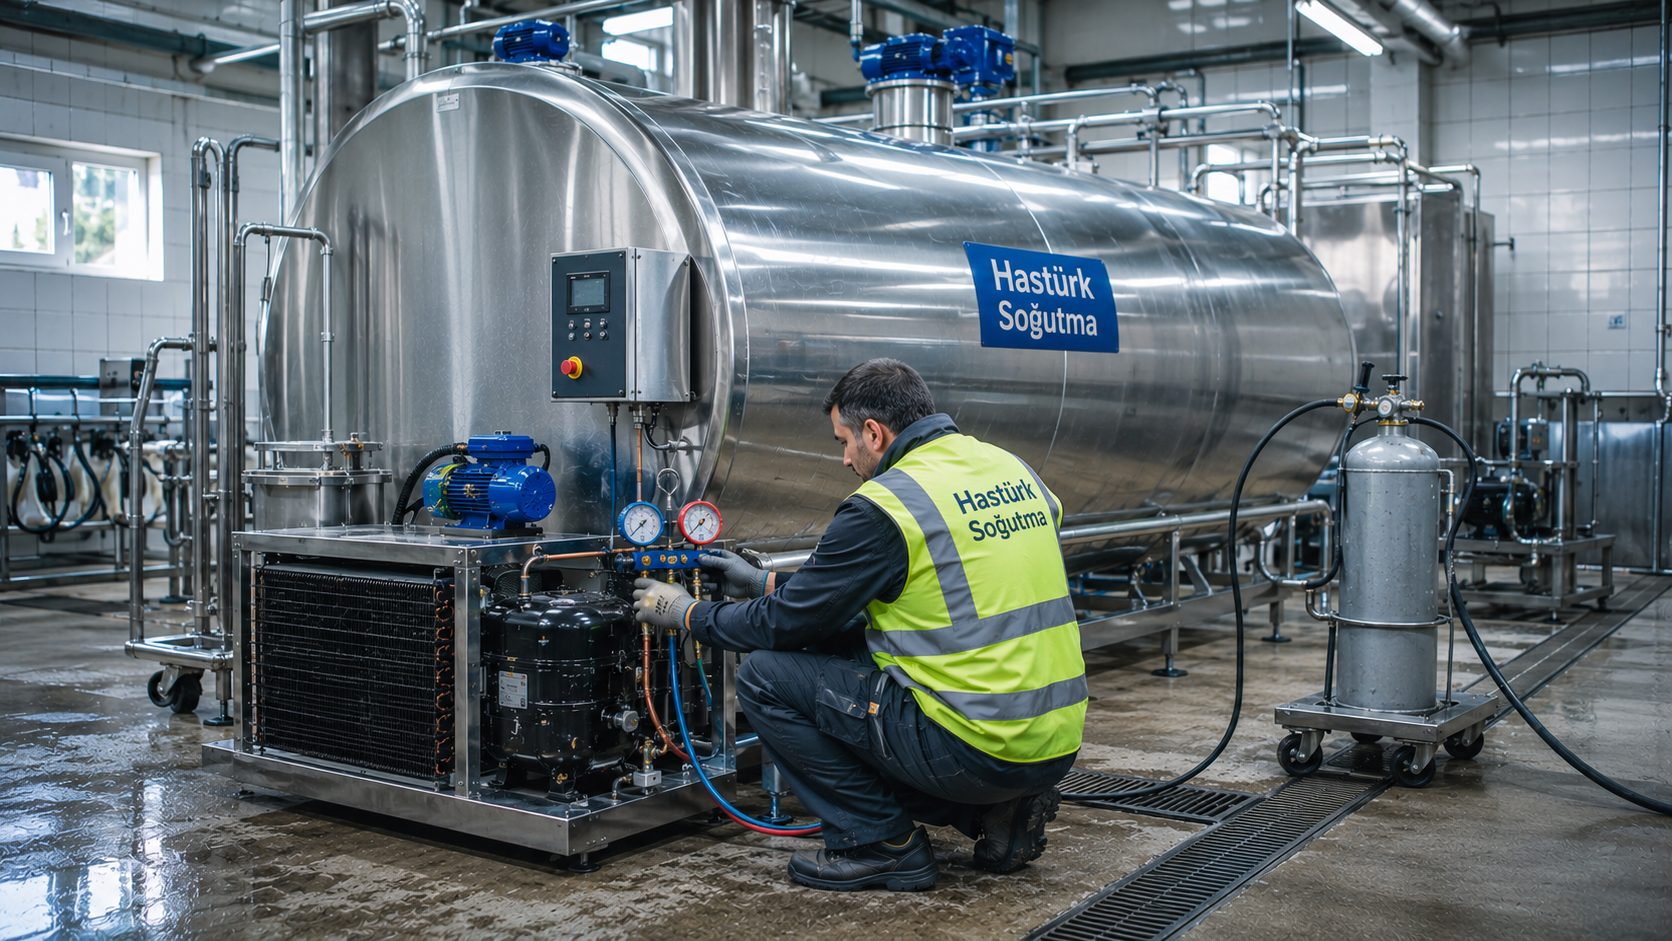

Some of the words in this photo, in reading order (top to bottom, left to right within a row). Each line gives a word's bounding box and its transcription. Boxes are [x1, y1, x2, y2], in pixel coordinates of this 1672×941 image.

[990, 258, 1095, 300] Hastürk
[998, 300, 1098, 340] Soğutma
[953, 479, 1038, 515] Hastürk
[968, 510, 1048, 542] Soğutma
